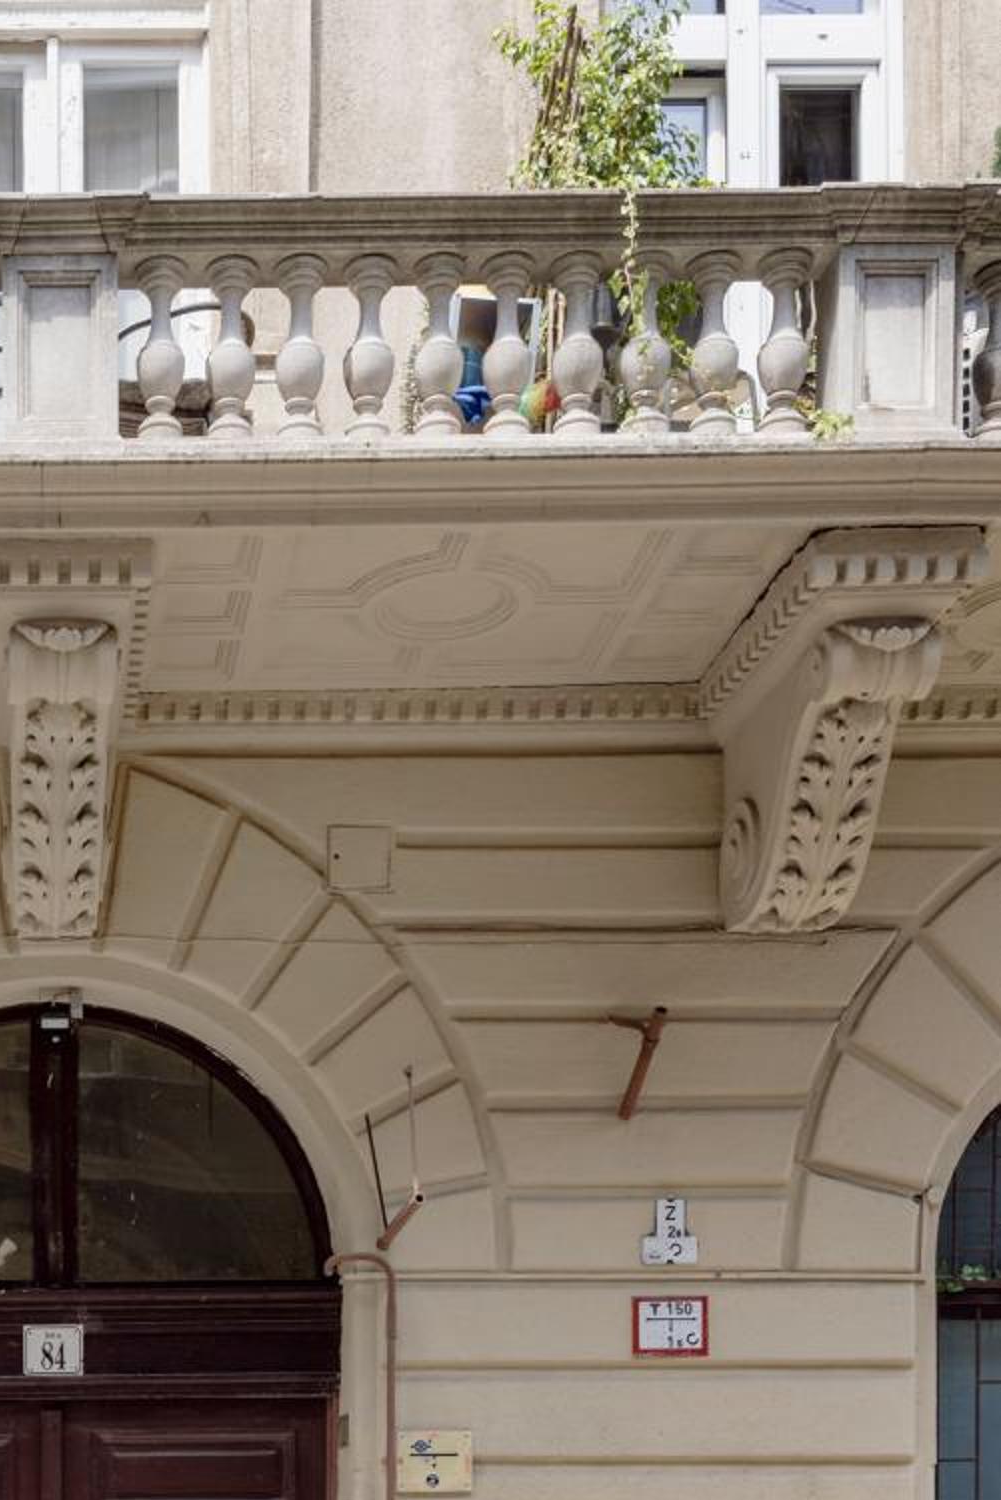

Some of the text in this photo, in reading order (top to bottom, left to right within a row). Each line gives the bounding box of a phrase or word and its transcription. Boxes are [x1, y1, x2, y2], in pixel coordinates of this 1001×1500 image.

[664, 1205, 676, 1221] Z
[649, 1303, 693, 1316] T 150
[41, 1341, 67, 1371] 84
